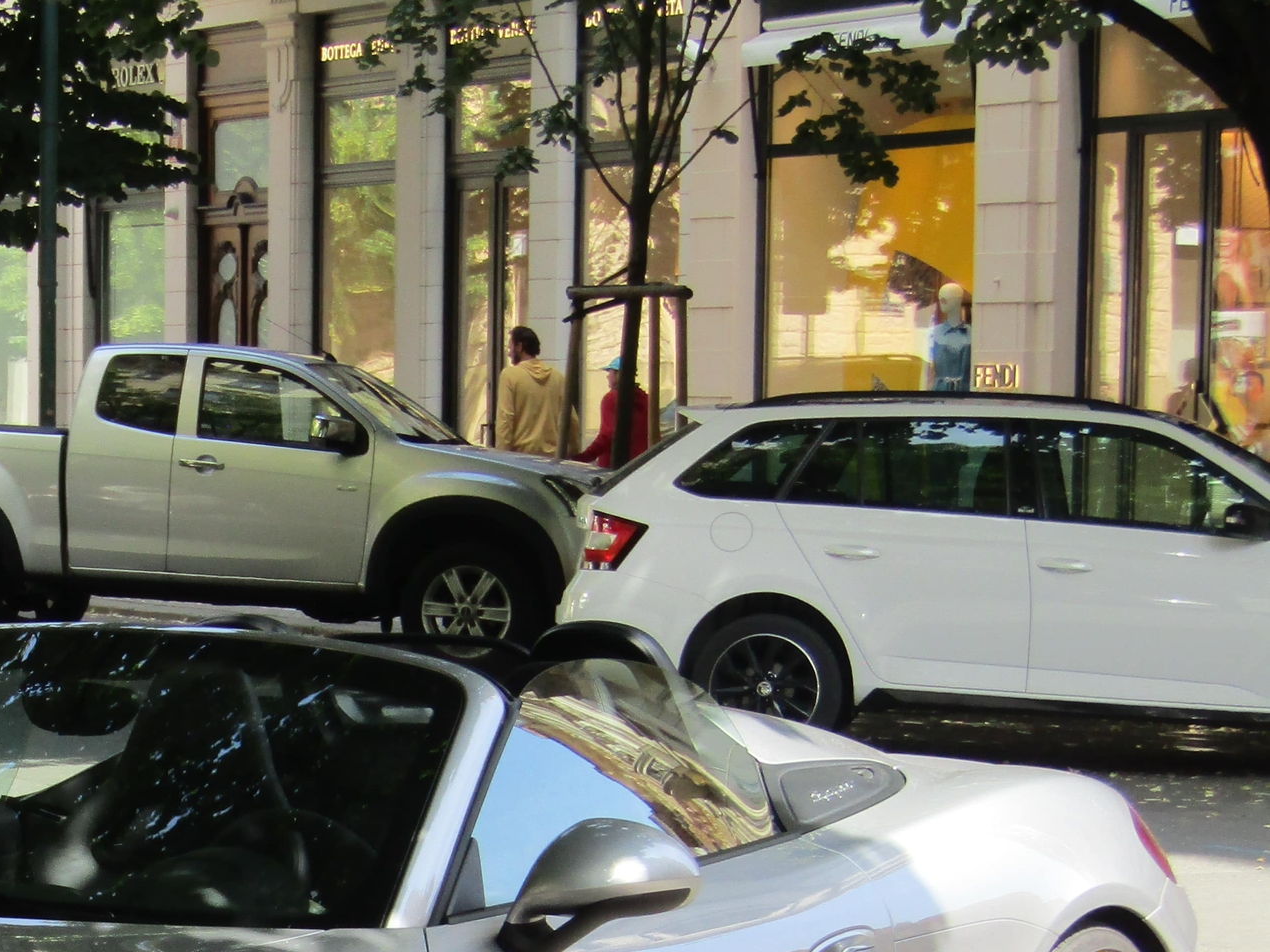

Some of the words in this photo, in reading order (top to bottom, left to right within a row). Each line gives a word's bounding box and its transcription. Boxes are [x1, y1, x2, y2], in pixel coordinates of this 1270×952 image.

[321, 43, 362, 62] BOTTEGA
[111, 62, 154, 88] ROLEX
[973, 364, 1020, 389] FENDI
